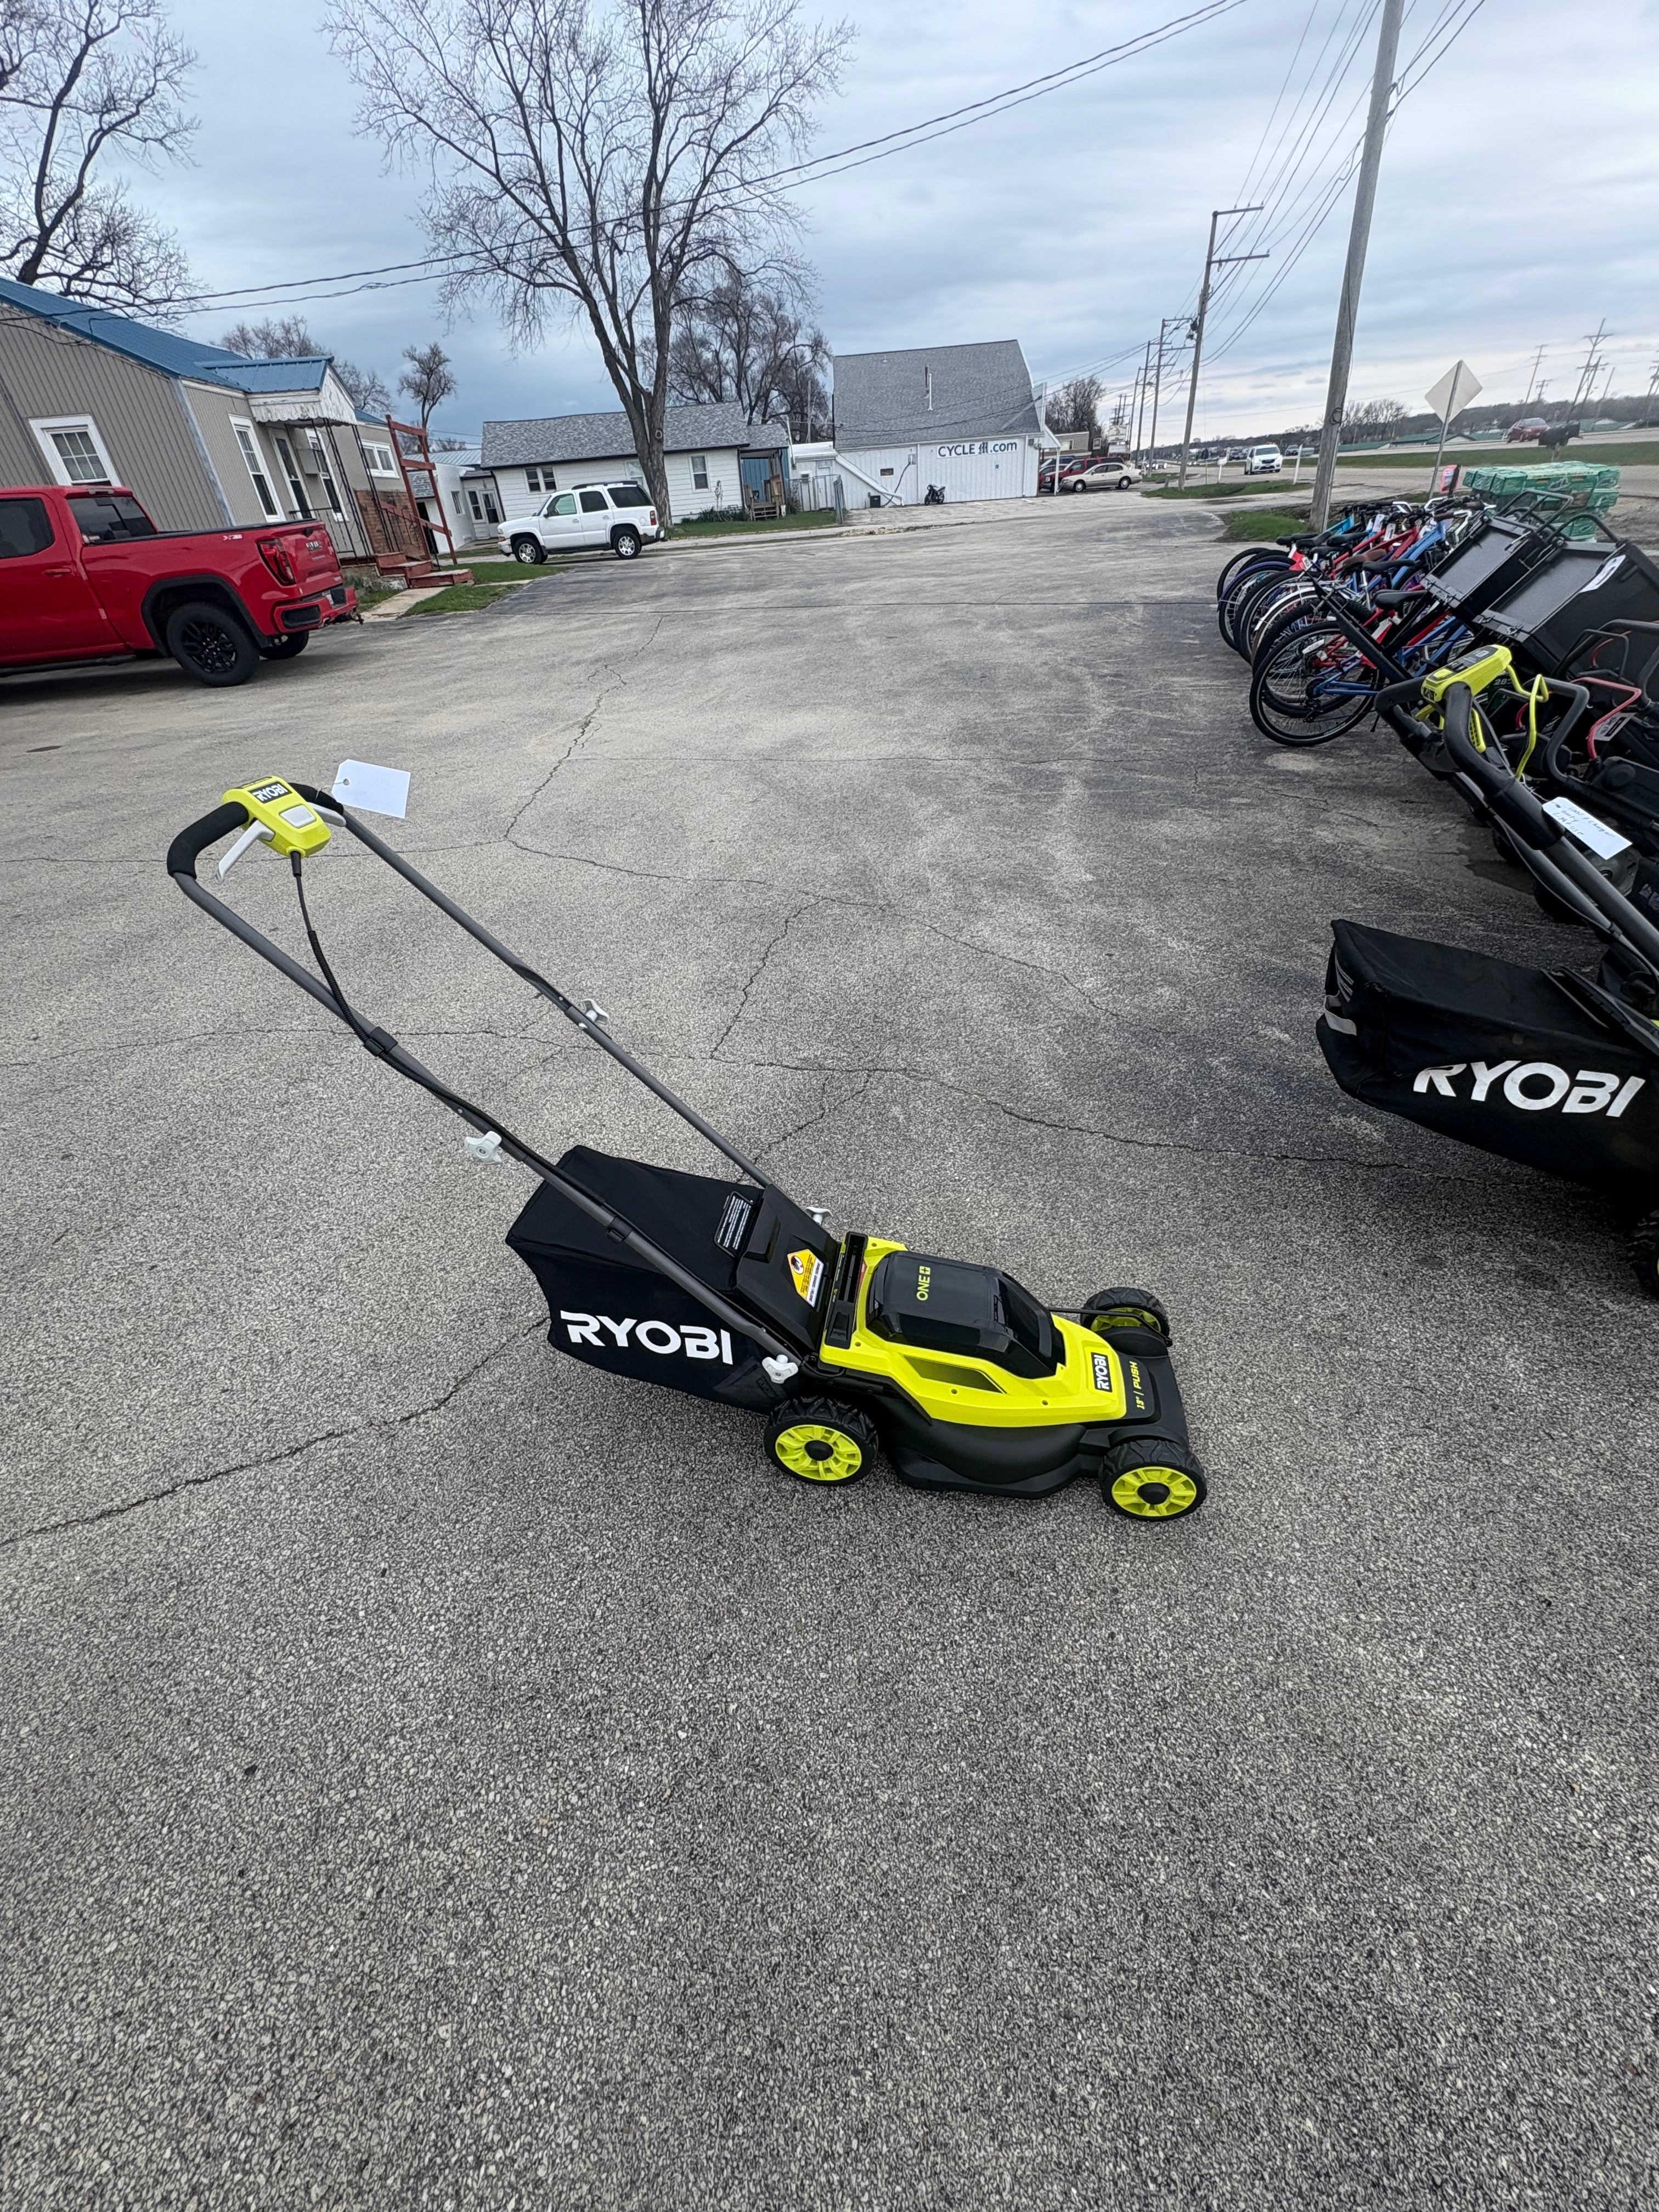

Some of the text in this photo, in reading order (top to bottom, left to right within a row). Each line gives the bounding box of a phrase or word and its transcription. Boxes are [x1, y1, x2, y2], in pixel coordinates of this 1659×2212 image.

[938, 444, 975, 457] CYCLE
[252, 783, 289, 802] RYOBI
[1413, 1060, 1646, 1118] RYOBI
[560, 1310, 733, 1365] RYOBI
[1093, 1355, 1110, 1390] RYOBI
[1129, 1361, 1142, 1390] PUSH
